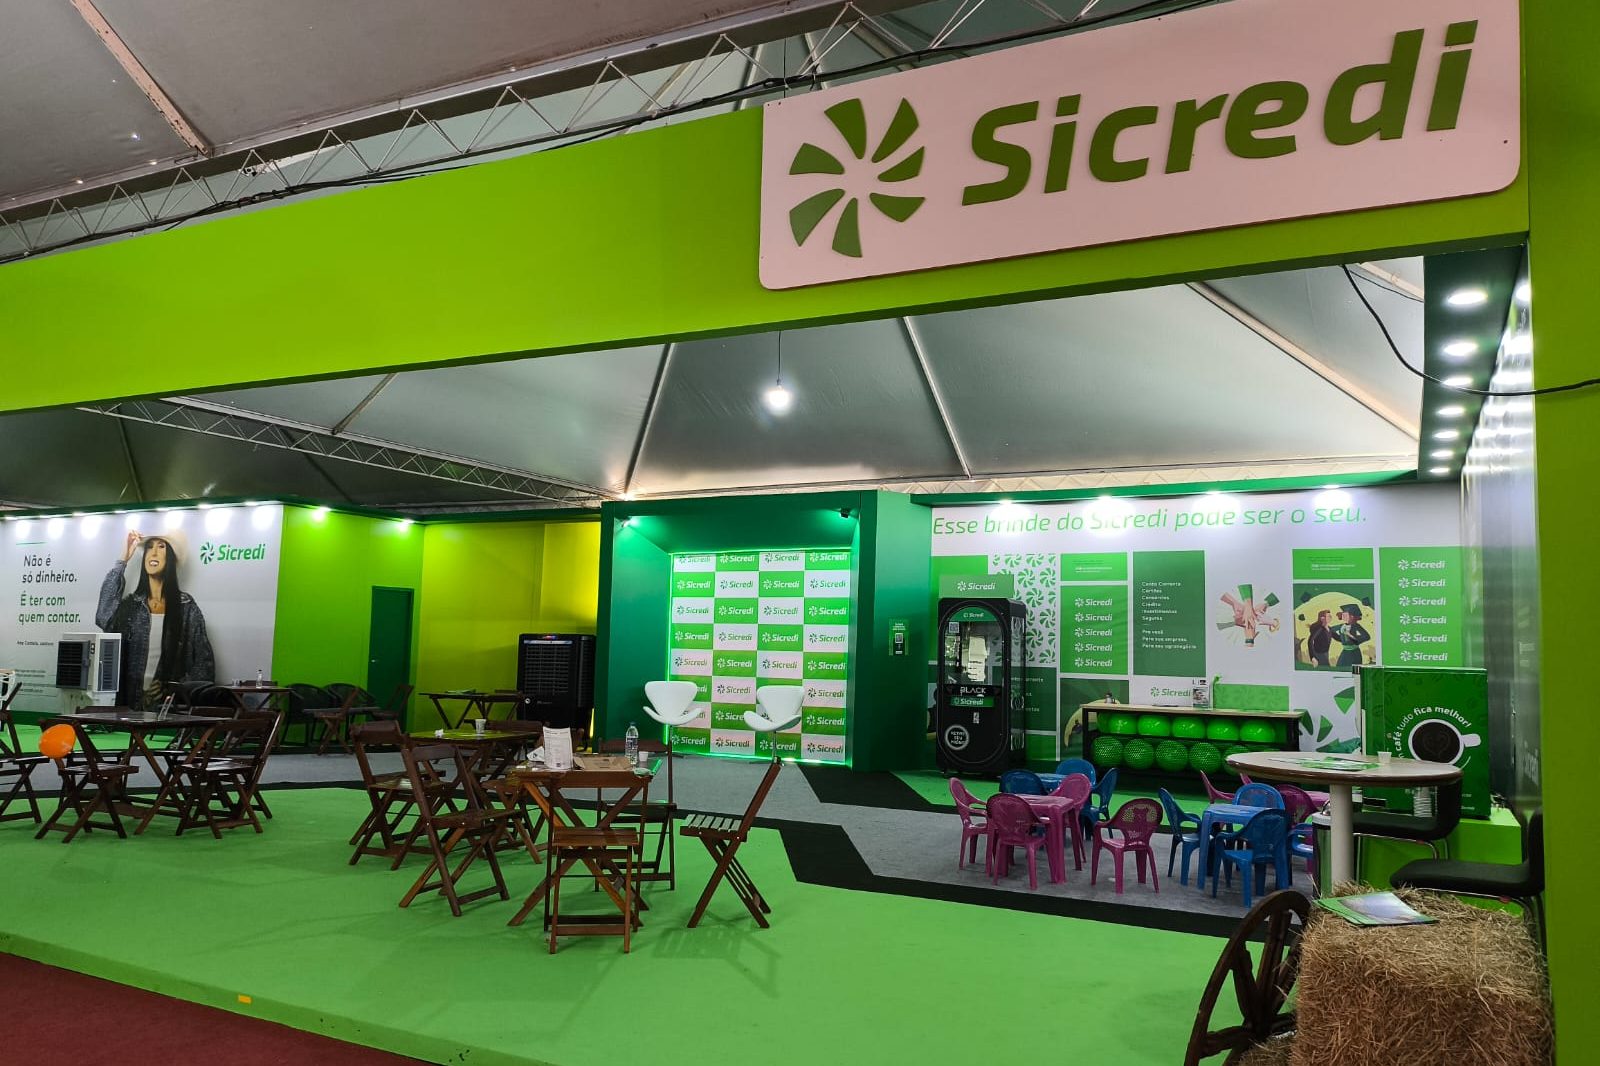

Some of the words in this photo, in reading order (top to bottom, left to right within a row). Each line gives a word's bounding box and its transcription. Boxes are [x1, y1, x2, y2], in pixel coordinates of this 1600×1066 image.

[962, 19, 1478, 205] Sicredi
[933, 517, 978, 534] Esse
[984, 514, 1050, 532] brinde
[1057, 512, 1084, 530] do
[1090, 508, 1168, 530] Sicredi
[1175, 509, 1236, 531] pode
[1243, 510, 1285, 524] ser
[1290, 509, 1305, 524] o
[1314, 507, 1367, 523] seu.
[217, 542, 266, 561] Sicredi
[774, 554, 800, 562] Sicredi
[820, 552, 848, 560] Sicredi
[24, 554, 44, 567] Não
[45, 554, 52, 567] é
[1411, 560, 1445, 569] Sicredi
[22, 570, 33, 584] só
[35, 570, 78, 584] dinheiro.
[686, 580, 711, 588] Sicredi
[730, 580, 754, 588] Sicredi
[773, 580, 800, 588] Sicredi
[820, 580, 846, 588] Sicredi
[968, 582, 996, 590] Sicredi
[1412, 578, 1446, 588] Sicredi
[20, 590, 28, 606] É
[30, 595, 44, 606] ter
[47, 596, 66, 606] com
[1085, 598, 1113, 606] Sicredi
[1412, 597, 1446, 606] Sicredi
[686, 606, 709, 614] Sicredi
[728, 606, 754, 614] Sicredi
[772, 607, 798, 615] Sicredi
[819, 608, 847, 616] Sicredi
[18, 613, 44, 626] quem
[47, 612, 81, 624] contar.
[1085, 614, 1113, 622] Sicredi
[1412, 616, 1446, 624] Sicredi
[684, 632, 710, 640] Sicredi
[1085, 628, 1113, 636] Sicredi
[772, 634, 798, 642] Sicredi
[819, 634, 846, 642] Sicredi
[1413, 634, 1448, 643] Sicredi
[1085, 644, 1113, 652] Sicredi
[1414, 652, 1448, 662] Sicredi
[684, 658, 708, 666] Sicredi
[726, 660, 752, 668] Sicredi
[772, 660, 798, 669] Sicredi
[818, 662, 846, 670] Sicredi
[1085, 658, 1113, 667] Sicredi
[726, 686, 751, 694] Sicredi
[818, 690, 844, 698] Sicredi
[960, 686, 986, 694] BLACK
[1162, 688, 1190, 697] Sicredi
[1414, 706, 1432, 716] fica
[724, 712, 745, 720] Sicre
[1434, 706, 1472, 728] melhor!
[816, 717, 844, 726] Sicredi
[1396, 714, 1414, 730] tudo
[680, 736, 706, 745] Sicredi
[724, 739, 750, 748] Sicredi
[1393, 732, 1402, 752] café
[769, 742, 796, 750] Scredi
[817, 745, 844, 754] Sicredi
